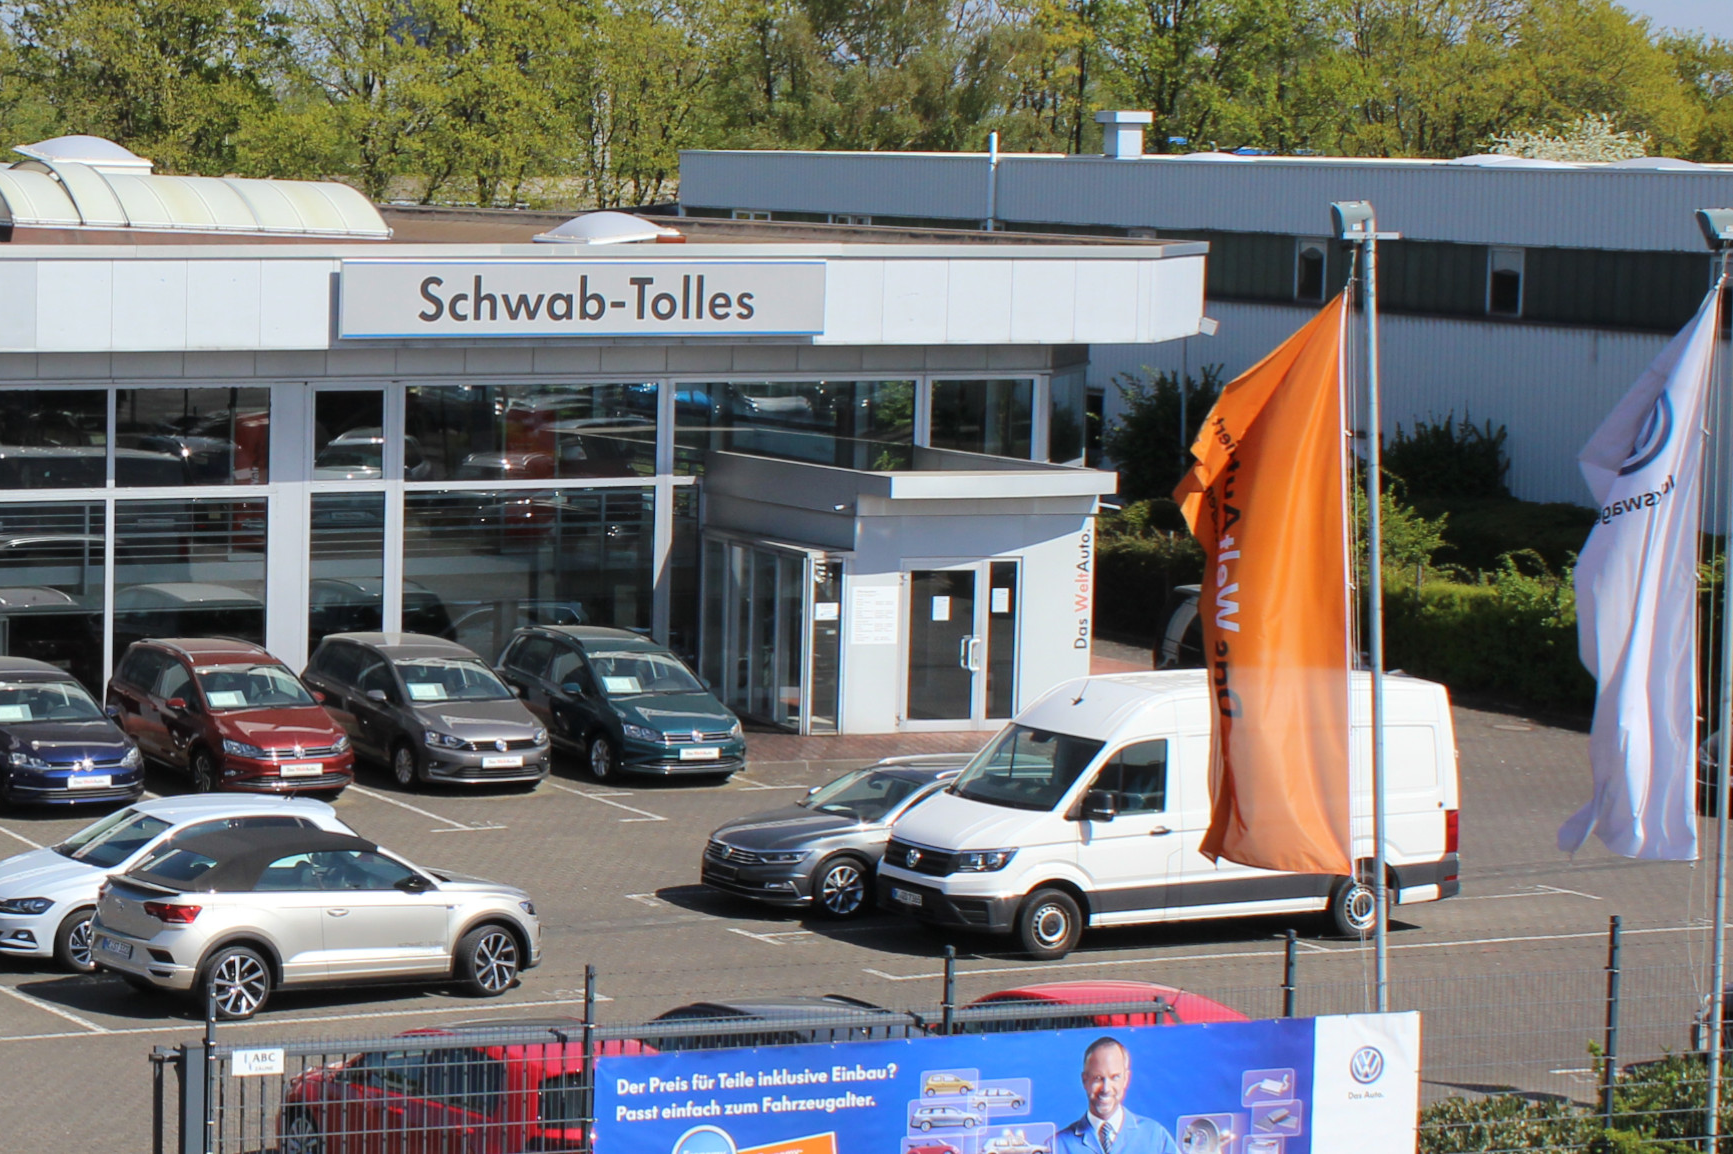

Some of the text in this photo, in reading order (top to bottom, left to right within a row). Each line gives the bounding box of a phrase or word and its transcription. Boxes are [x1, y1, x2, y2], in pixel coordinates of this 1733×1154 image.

[418, 274, 755, 322] Schwab-Tolles
[1073, 528, 1091, 649] Das WeltAuto.
[252, 1052, 276, 1063] ABC
[616, 1063, 898, 1095] Der Preis für Teile inklusive Einbau?
[616, 1091, 876, 1122] Passt einfach zum Fahrzeugalter.
[1348, 1091, 1362, 1100] Das
